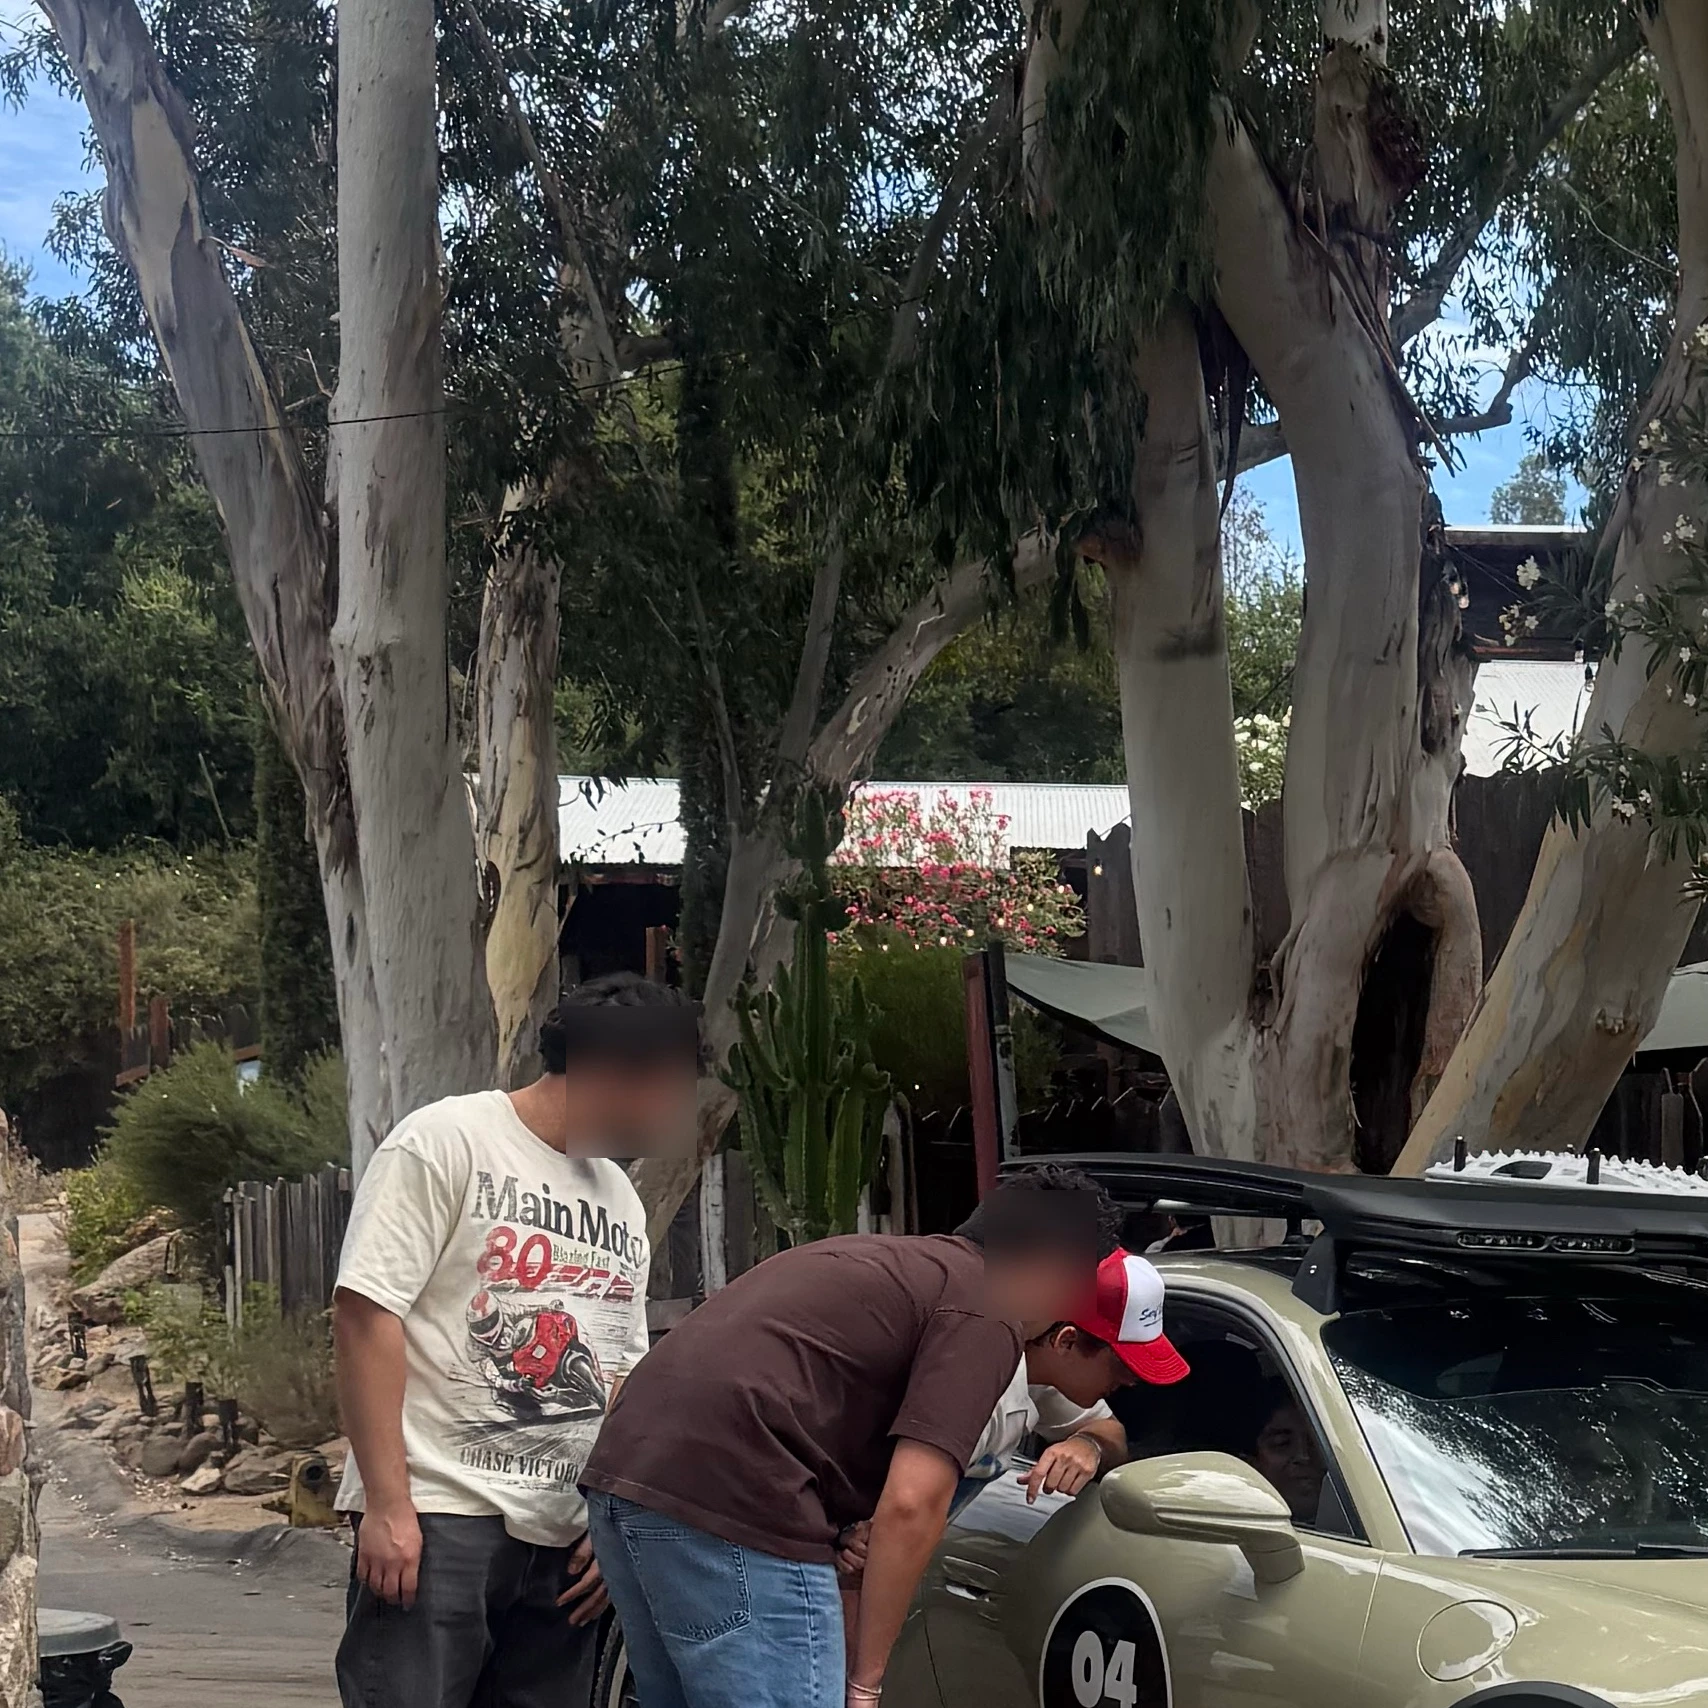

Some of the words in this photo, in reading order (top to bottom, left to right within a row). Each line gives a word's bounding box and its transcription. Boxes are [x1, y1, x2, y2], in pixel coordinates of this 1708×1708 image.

[471, 1171, 574, 1239] Main
[477, 1226, 551, 1289] 80
[460, 1447, 514, 1473] CHASE
